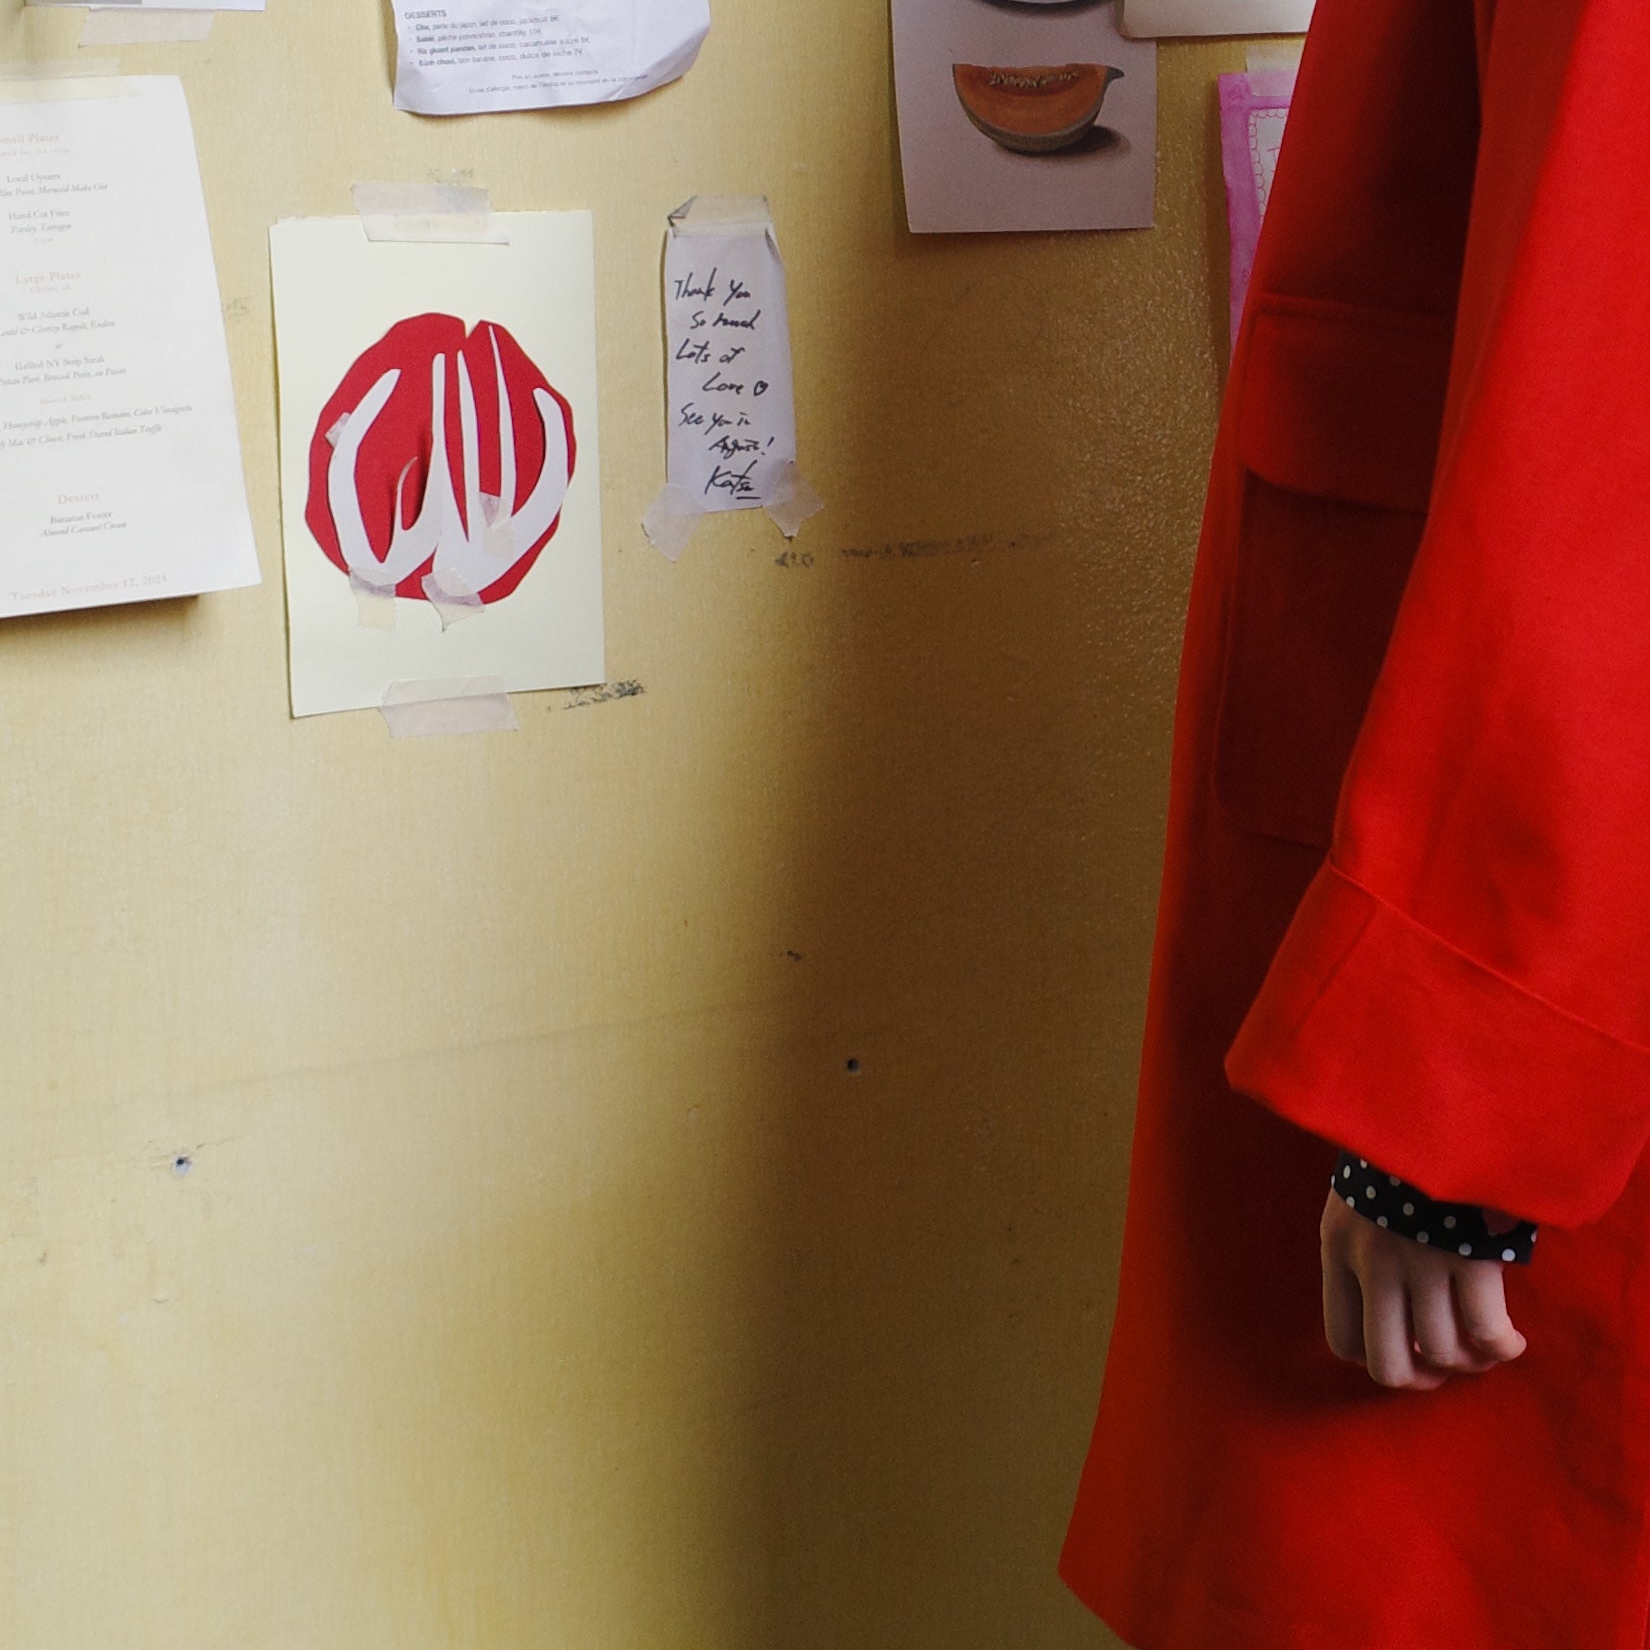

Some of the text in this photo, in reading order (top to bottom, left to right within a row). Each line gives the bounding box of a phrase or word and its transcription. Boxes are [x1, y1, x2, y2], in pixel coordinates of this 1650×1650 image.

[404, 9, 447, 20] DESSERTS
[674, 267, 716, 301] Thank
[676, 338, 711, 364] Lots
[702, 371, 745, 395] Love
[679, 402, 705, 426] See
